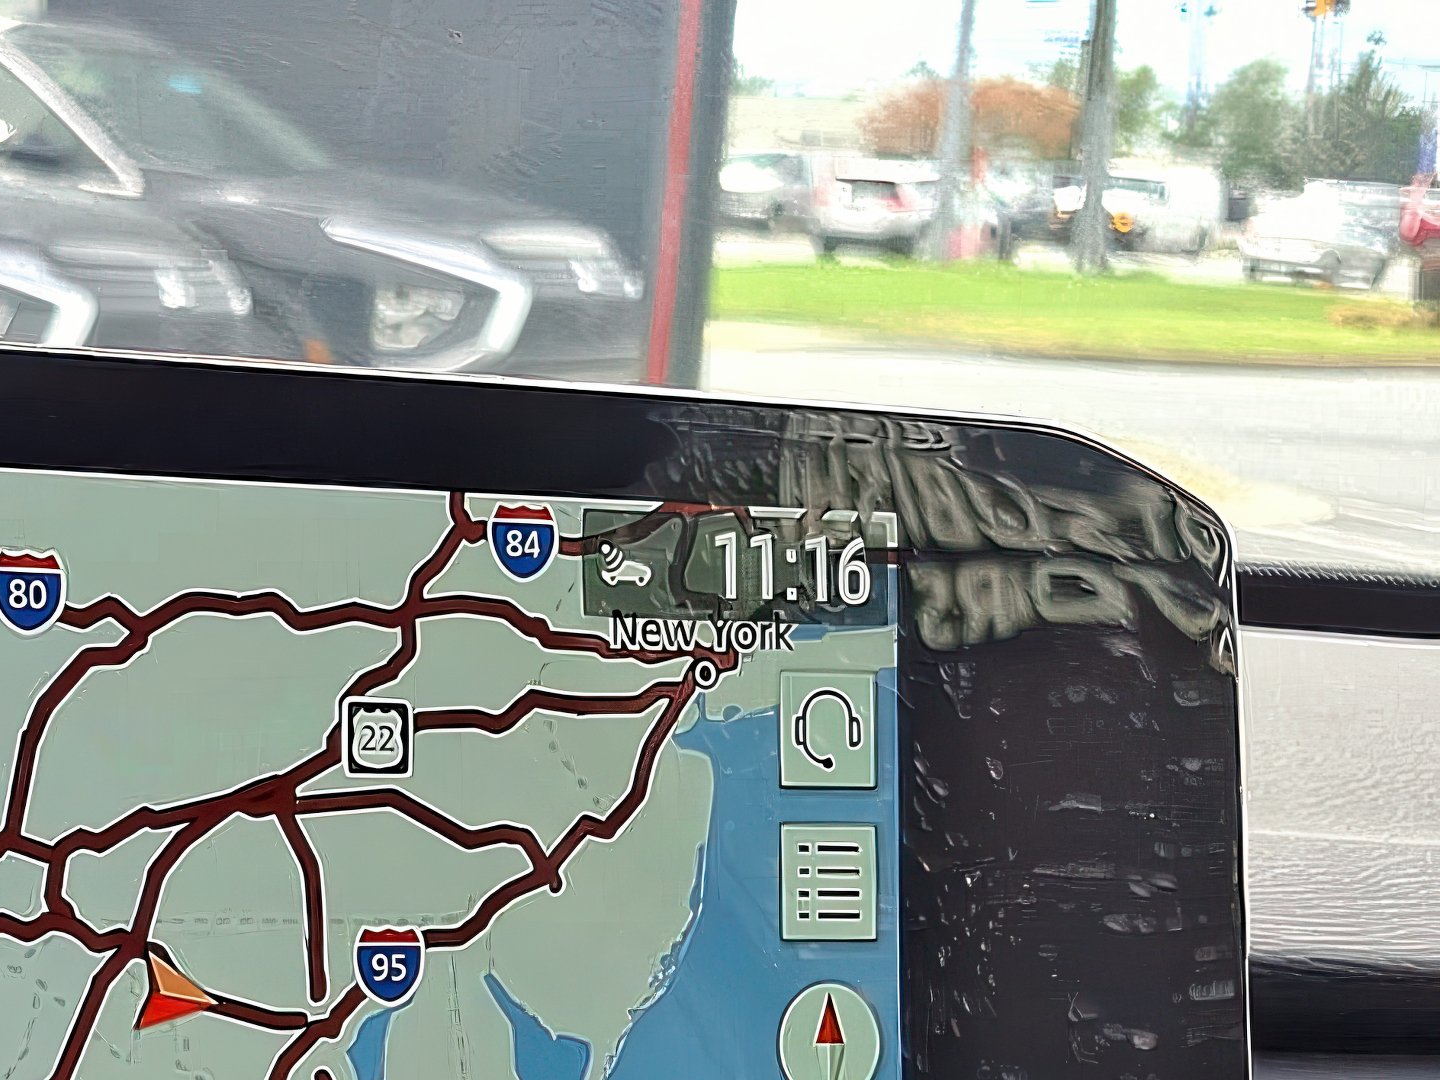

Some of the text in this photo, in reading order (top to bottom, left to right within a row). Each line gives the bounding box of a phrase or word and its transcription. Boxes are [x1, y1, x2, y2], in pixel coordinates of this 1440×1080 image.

[505, 527, 542, 558] 84
[714, 530, 872, 606] 11:16
[7, 577, 48, 610] 80
[612, 614, 795, 656] New York
[358, 724, 396, 753] 22
[370, 952, 408, 983] 95
